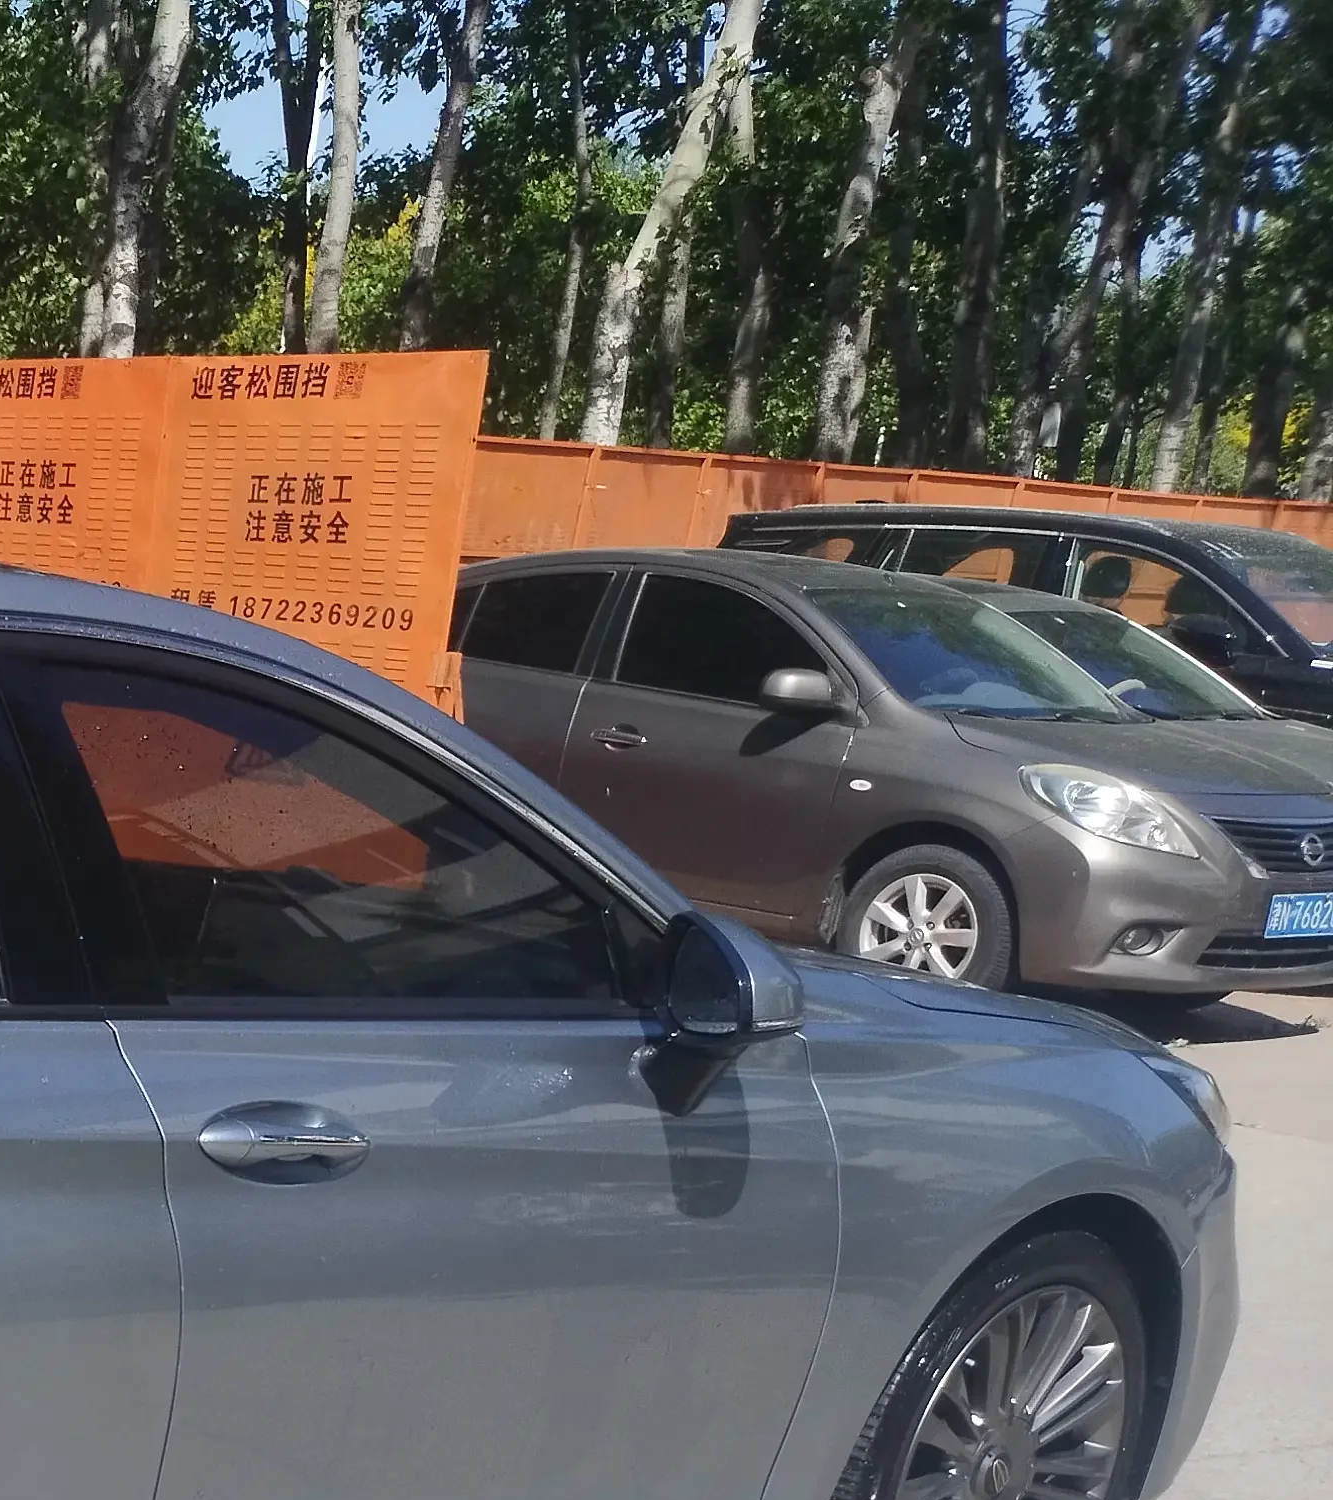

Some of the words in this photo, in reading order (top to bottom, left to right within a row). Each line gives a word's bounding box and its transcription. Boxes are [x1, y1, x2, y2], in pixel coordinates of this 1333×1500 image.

[190, 362, 331, 400] 迎客松围挡
[247, 472, 353, 506] 正在施工
[244, 510, 350, 544] 注意安全
[229, 595, 414, 631] 18722369209
